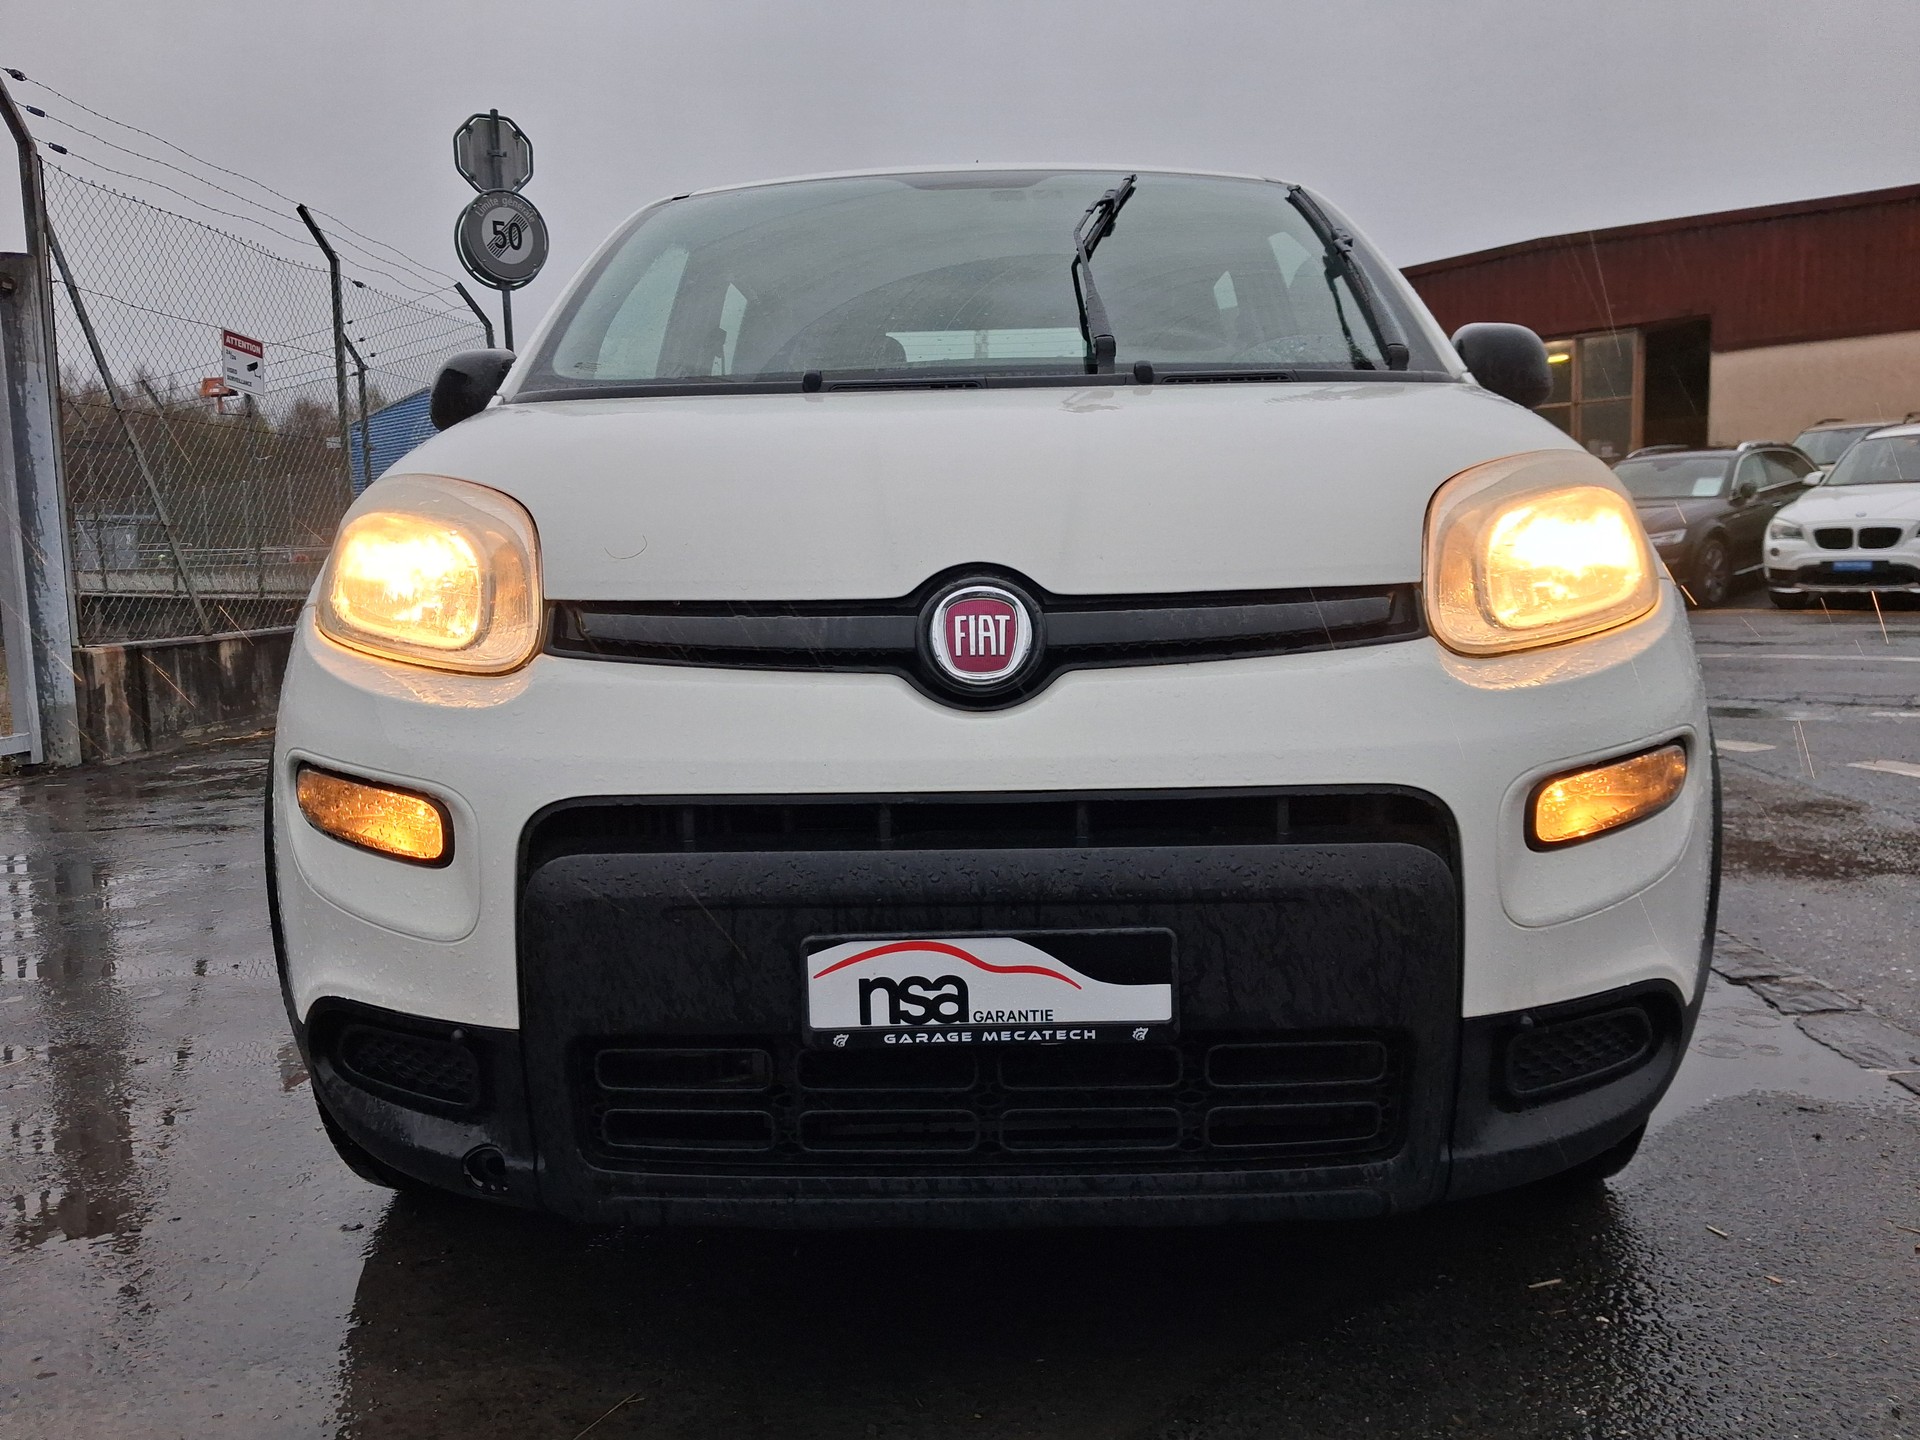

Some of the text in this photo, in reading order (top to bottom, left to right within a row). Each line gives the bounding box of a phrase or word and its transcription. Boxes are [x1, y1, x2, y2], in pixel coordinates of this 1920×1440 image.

[492, 221, 523, 250] 50
[226, 335, 261, 354] ATTENTION
[954, 615, 1011, 657] FIAT
[858, 974, 969, 1026] nsa
[973, 1009, 1054, 1023] GARANTIE
[884, 1029, 1097, 1044] GARAGE MECATECH
